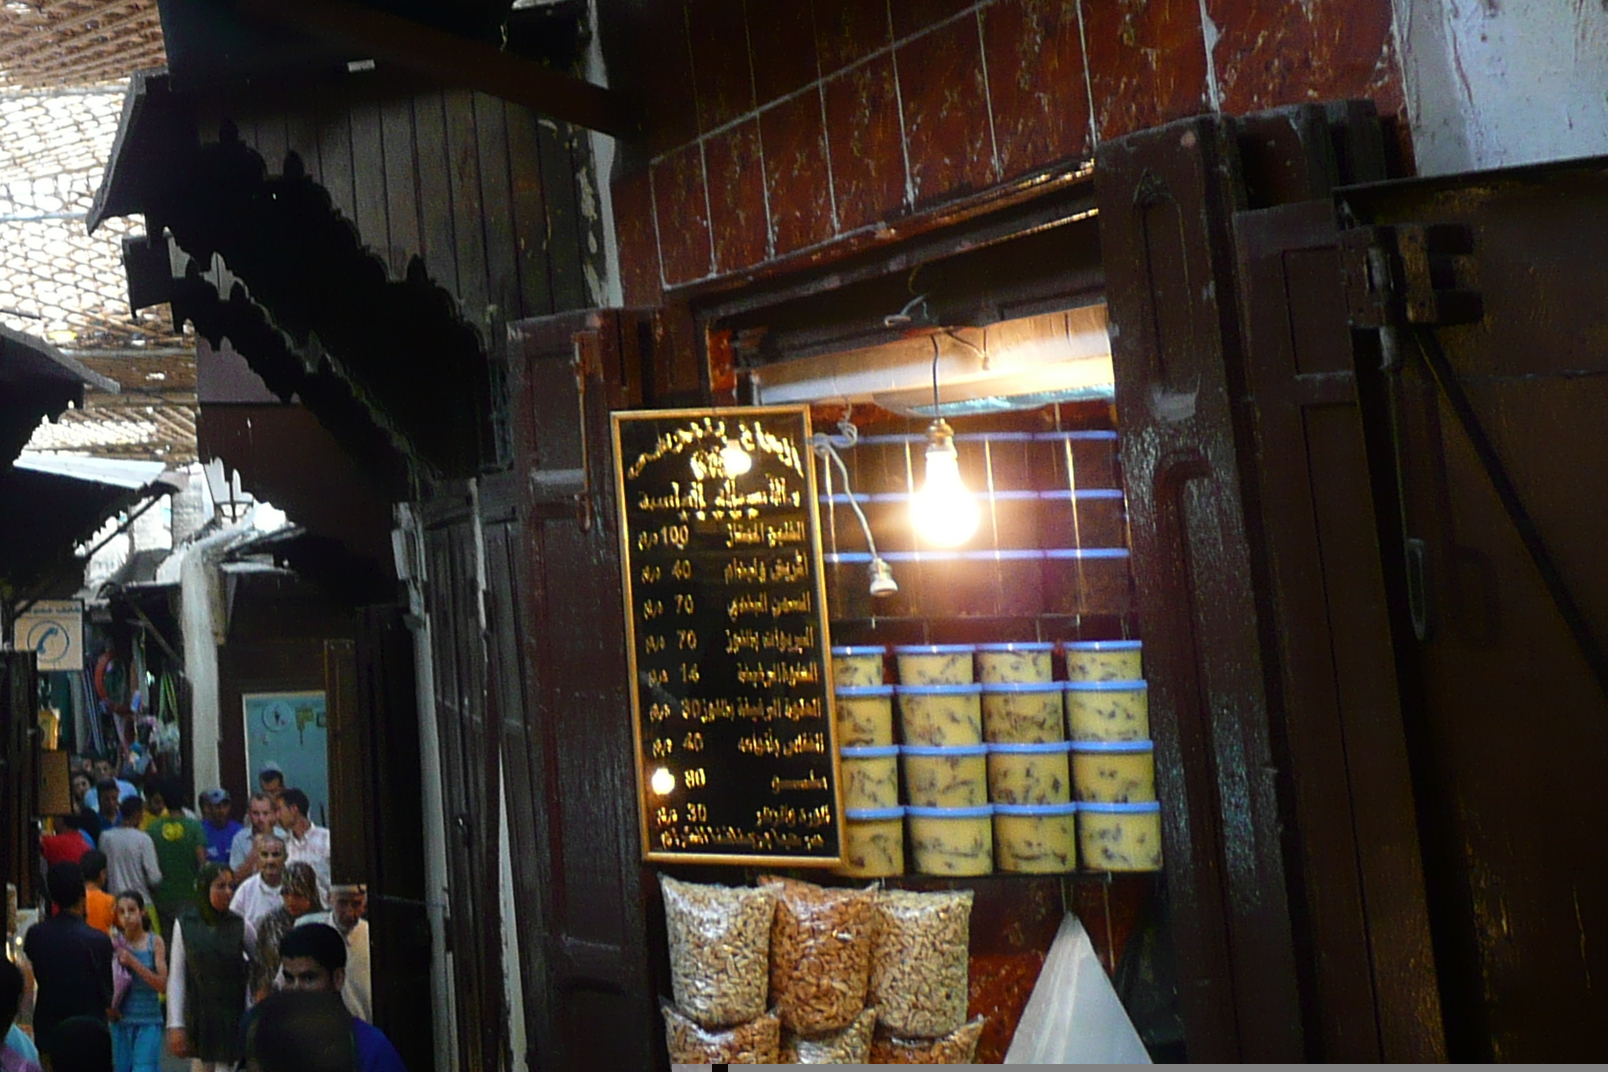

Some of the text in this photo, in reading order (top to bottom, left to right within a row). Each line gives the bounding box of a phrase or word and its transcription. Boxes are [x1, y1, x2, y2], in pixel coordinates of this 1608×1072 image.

[661, 524, 689, 545] 100
[672, 560, 692, 580] 40
[675, 594, 694, 615] 70
[677, 629, 697, 650] 70
